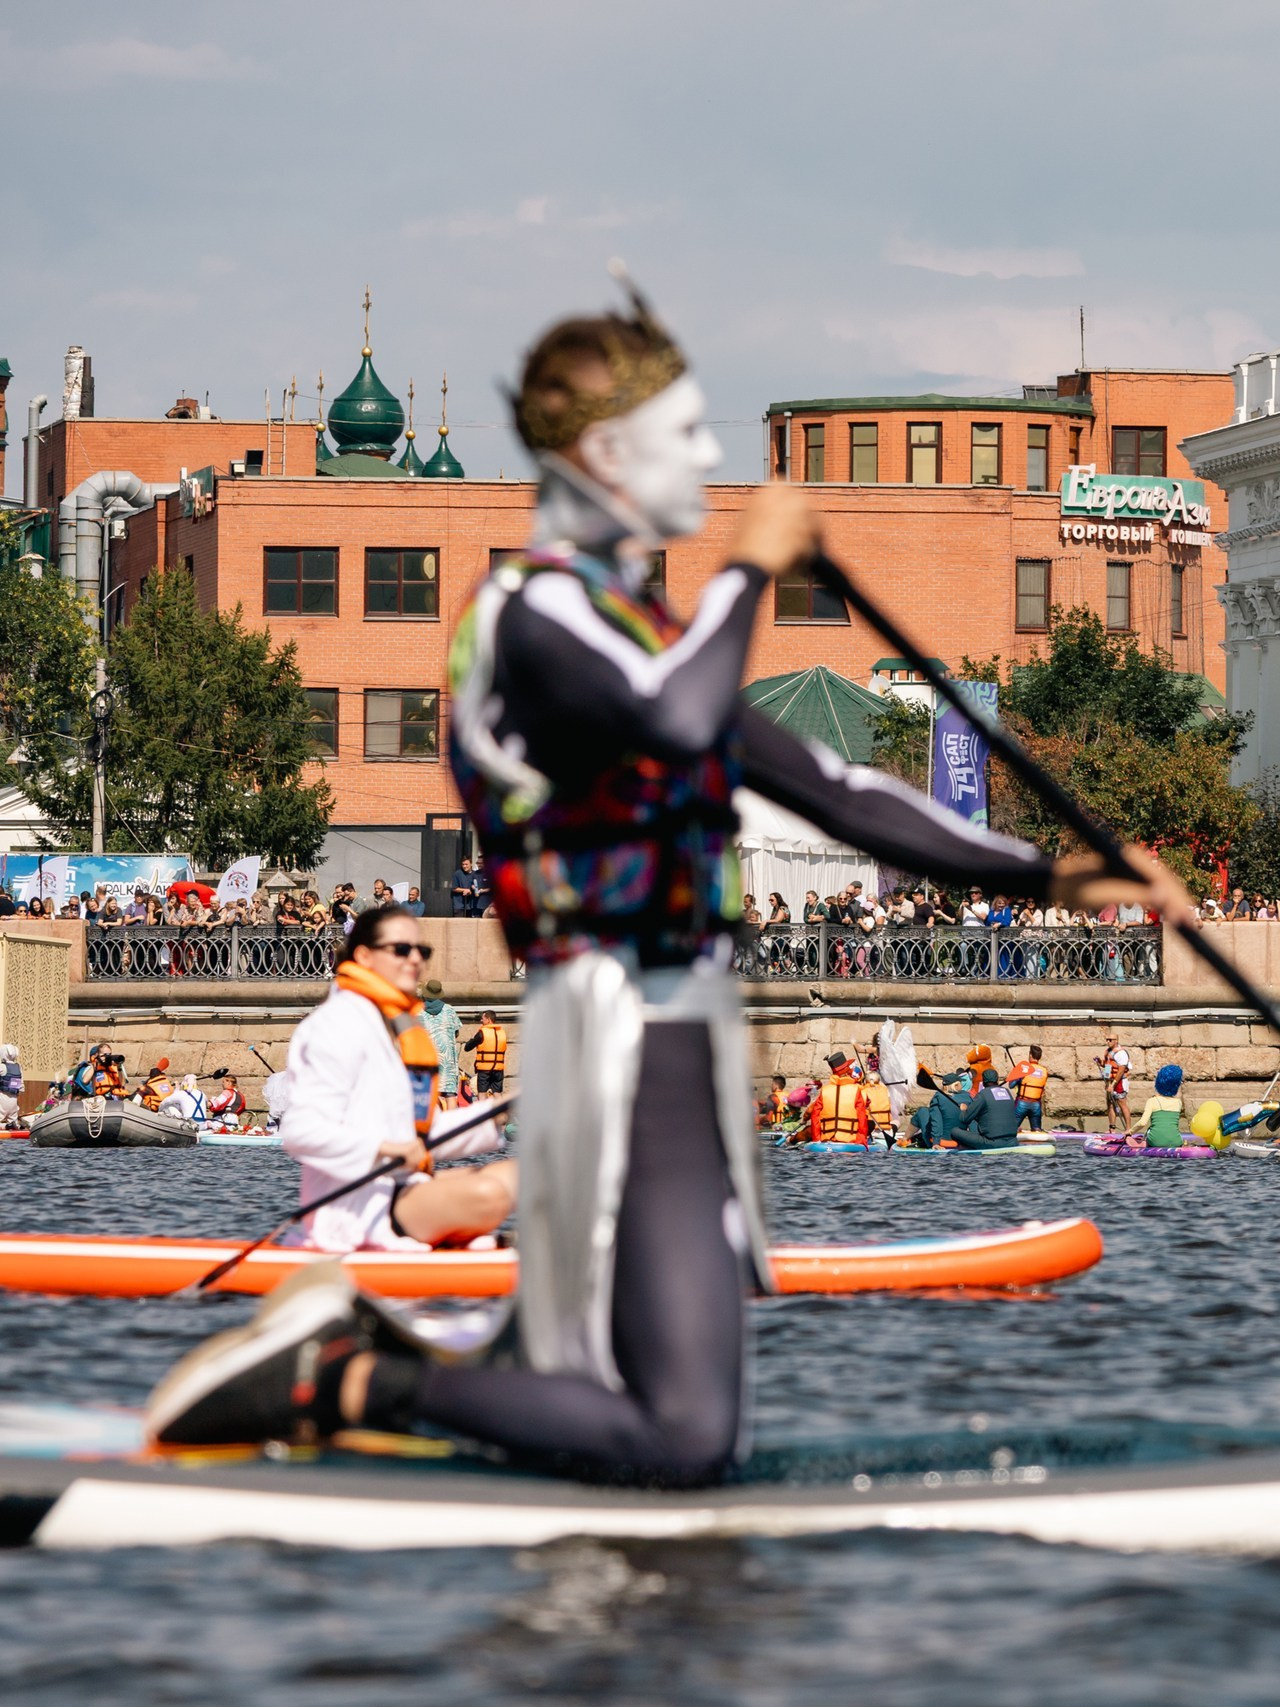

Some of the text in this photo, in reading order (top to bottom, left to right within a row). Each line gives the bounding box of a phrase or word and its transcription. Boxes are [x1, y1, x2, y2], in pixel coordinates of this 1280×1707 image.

[1063, 463, 1167, 519] Европа
[1061, 522, 1155, 542] ТОРГОВЫЙ
[954, 766, 976, 801] 74
